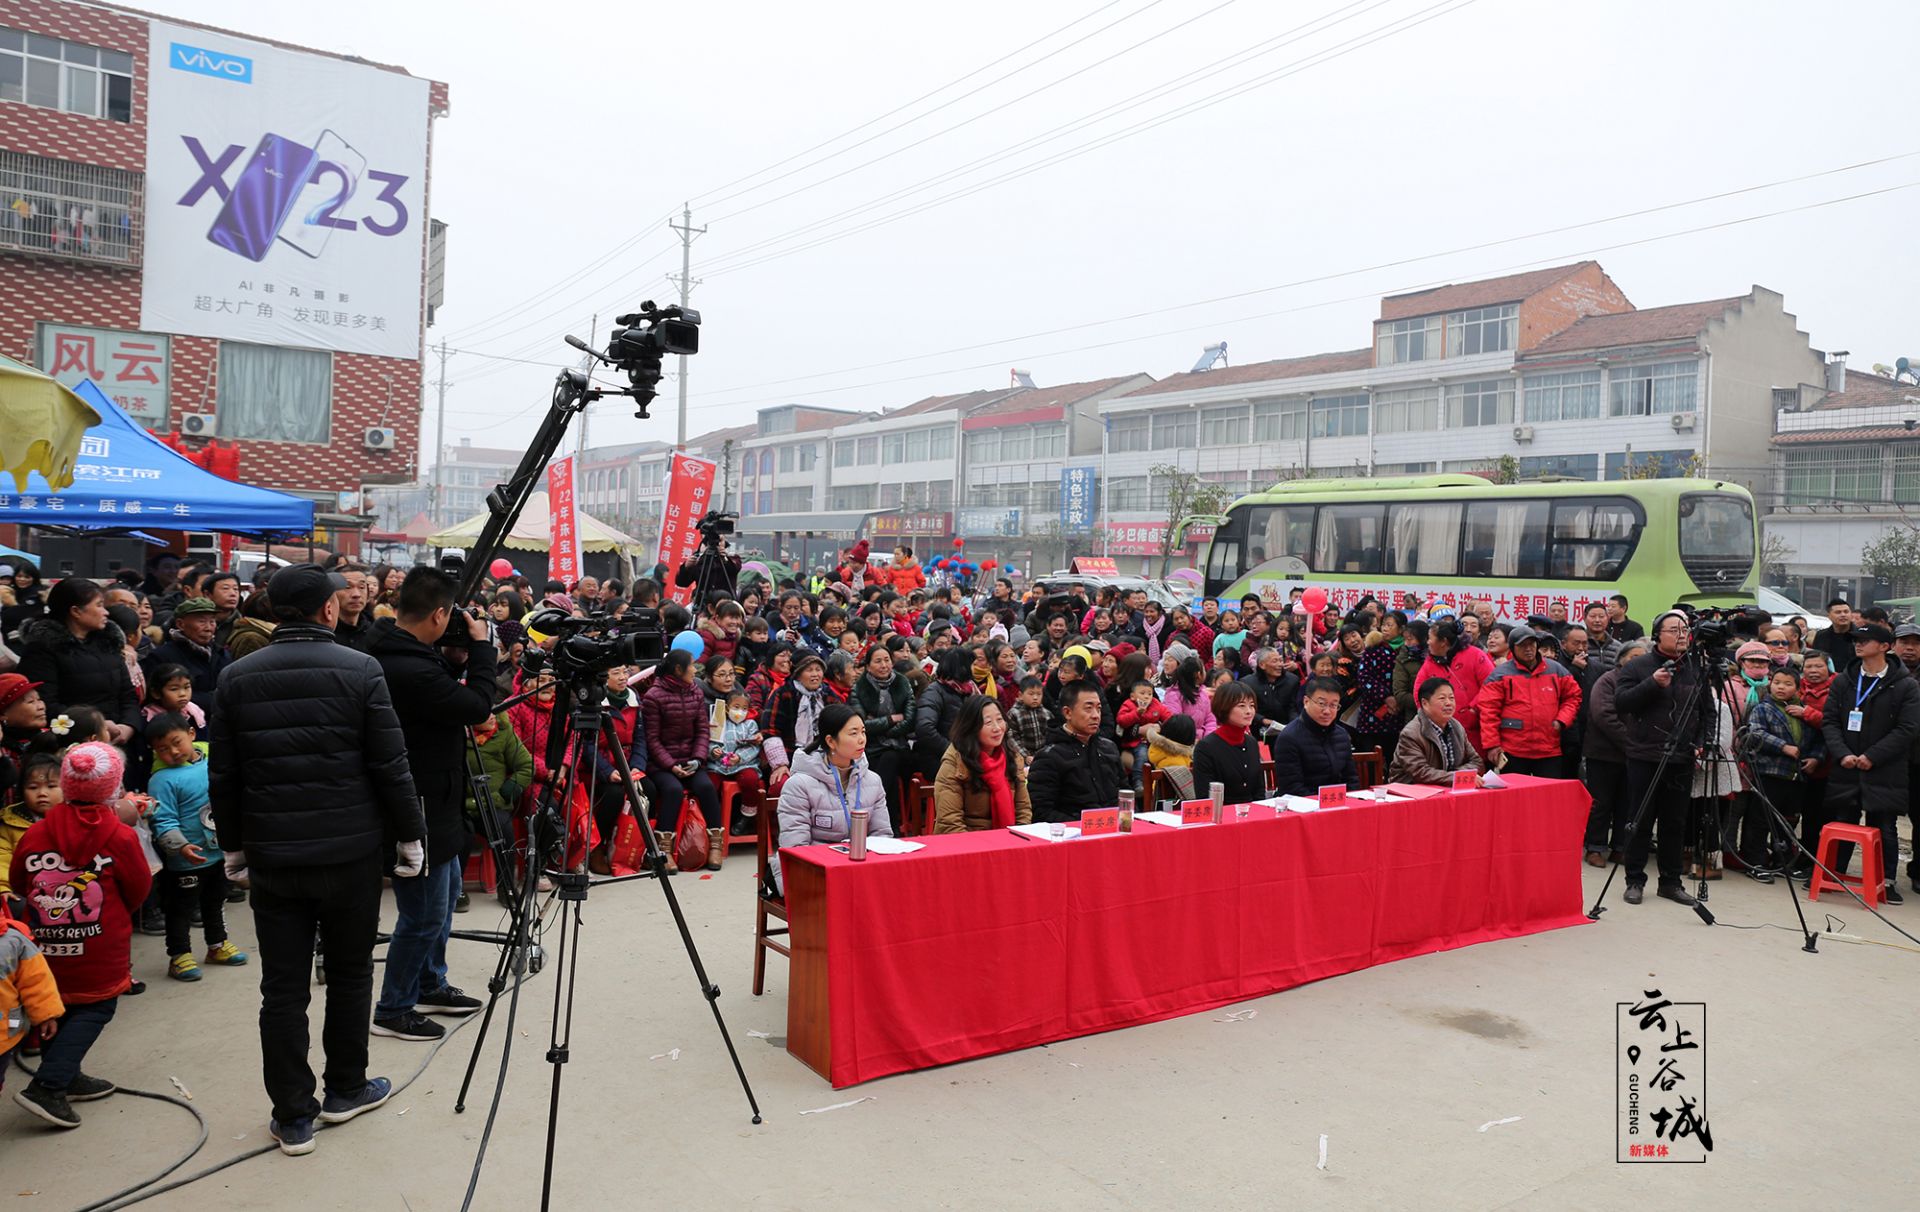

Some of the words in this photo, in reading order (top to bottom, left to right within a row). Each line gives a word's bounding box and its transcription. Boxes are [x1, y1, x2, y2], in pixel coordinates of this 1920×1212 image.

[176, 50, 247, 77] vivo
[238, 280, 253, 291] AI
[263, 283, 349, 303] 非凡摄影
[193, 294, 274, 319] 超大广角
[293, 306, 388, 332] 发现更多美
[48, 332, 163, 385] 风云
[558, 489, 575, 597] 22年珠宝老字
[1084, 815, 1117, 829] 评委席
[25, 851, 113, 873] GOY
[66, 923, 103, 940] REVUE
